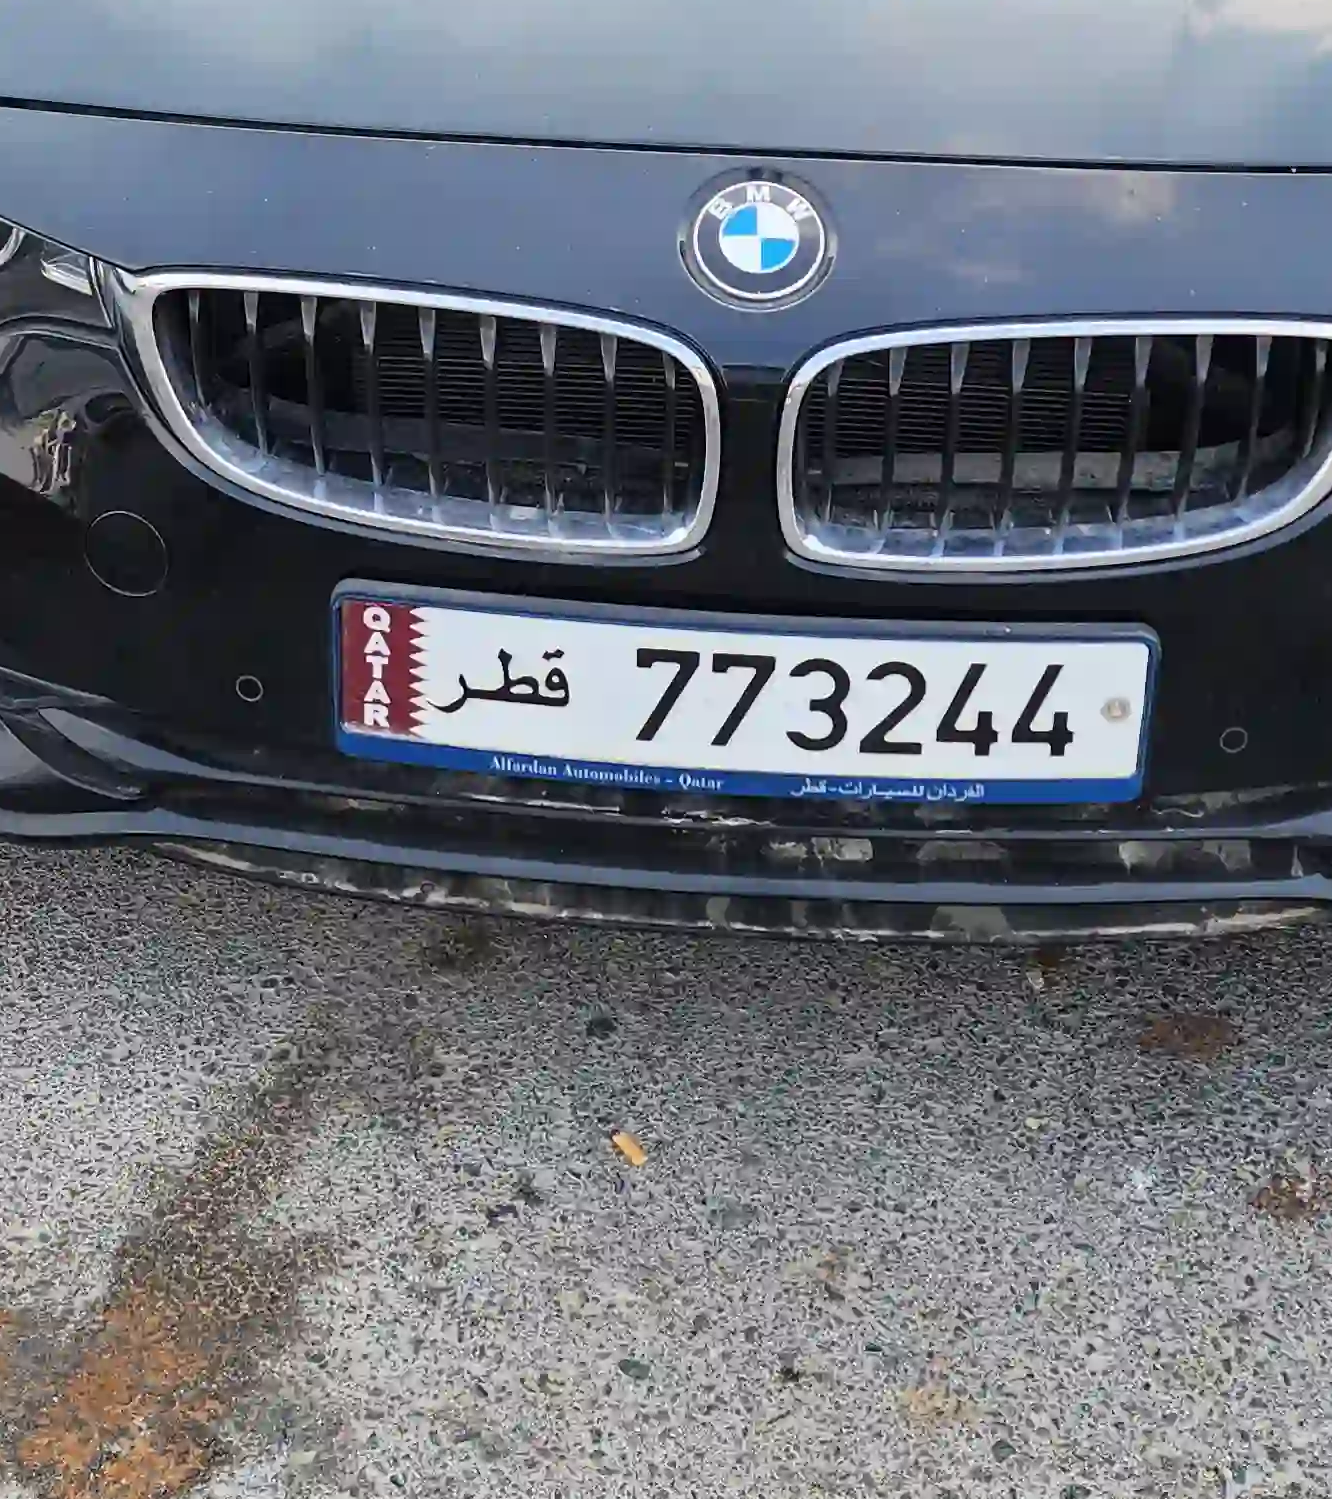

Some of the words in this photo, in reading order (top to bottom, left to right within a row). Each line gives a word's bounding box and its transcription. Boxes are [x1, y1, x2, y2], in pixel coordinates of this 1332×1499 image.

[708, 185, 815, 221] BMW
[363, 606, 392, 728] QATAR
[425, 647, 570, 713] قطر
[636, 648, 1074, 756] 773244
[490, 755, 557, 776] Alfardan
[563, 761, 660, 785] Automobiles
[678, 773, 725, 790] Qatar
